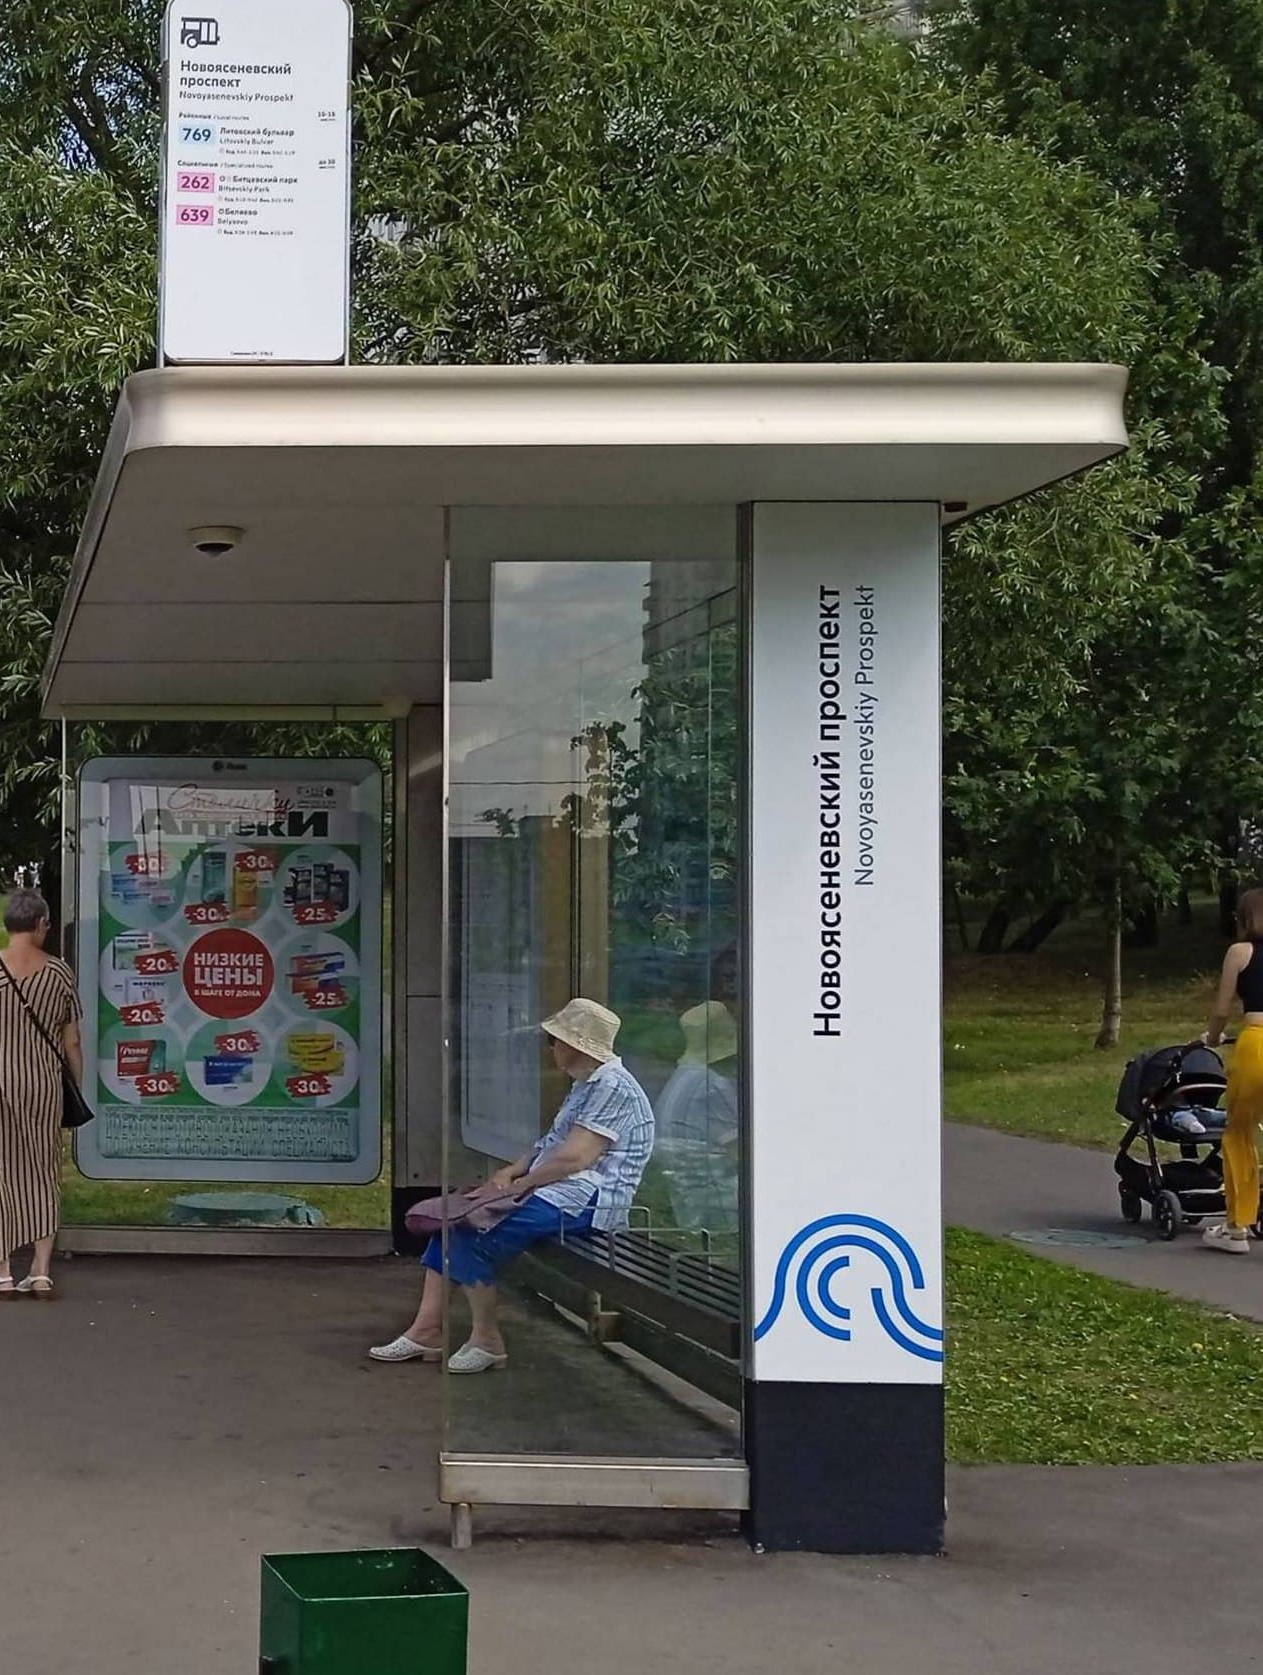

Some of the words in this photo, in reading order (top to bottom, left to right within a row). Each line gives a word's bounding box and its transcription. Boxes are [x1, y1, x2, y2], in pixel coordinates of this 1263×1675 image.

[180, 60, 292, 75] Новоясеневский
[179, 76, 241, 88] проспект
[179, 90, 253, 102] Novoyasenevskiy
[254, 93, 294, 103] Prospekt
[182, 127, 211, 142] 769
[181, 175, 210, 190] 262
[180, 208, 209, 222] 639
[853, 585, 879, 685] Prospekt
[819, 585, 847, 741] проспект
[854, 691, 879, 886] Novoyasenevskiy
[812, 751, 842, 1037] Новоясеневский
[193, 952, 264, 967] НИЗКИЕ
[194, 967, 263, 988] ЦЕНЫ
[224, 989, 235, 997] ОТ
[235, 989, 261, 998] ДОМА
